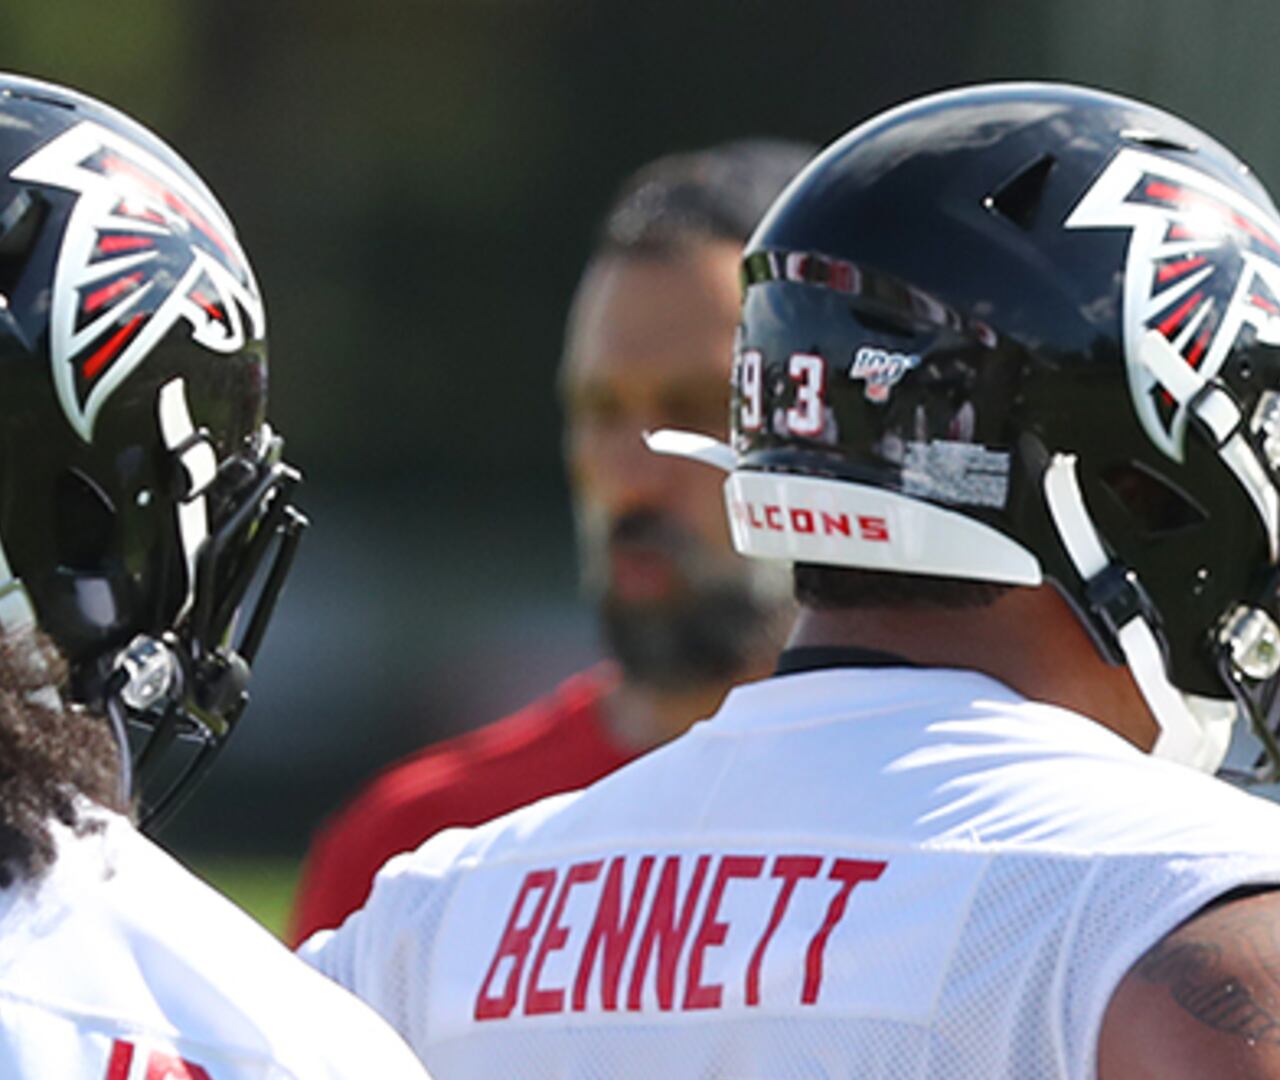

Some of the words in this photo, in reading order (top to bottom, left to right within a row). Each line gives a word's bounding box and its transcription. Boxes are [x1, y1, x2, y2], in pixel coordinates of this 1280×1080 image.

[740, 350, 824, 436] 93
[737, 503, 891, 543] LCONS
[473, 855, 888, 1021] BENNETT
